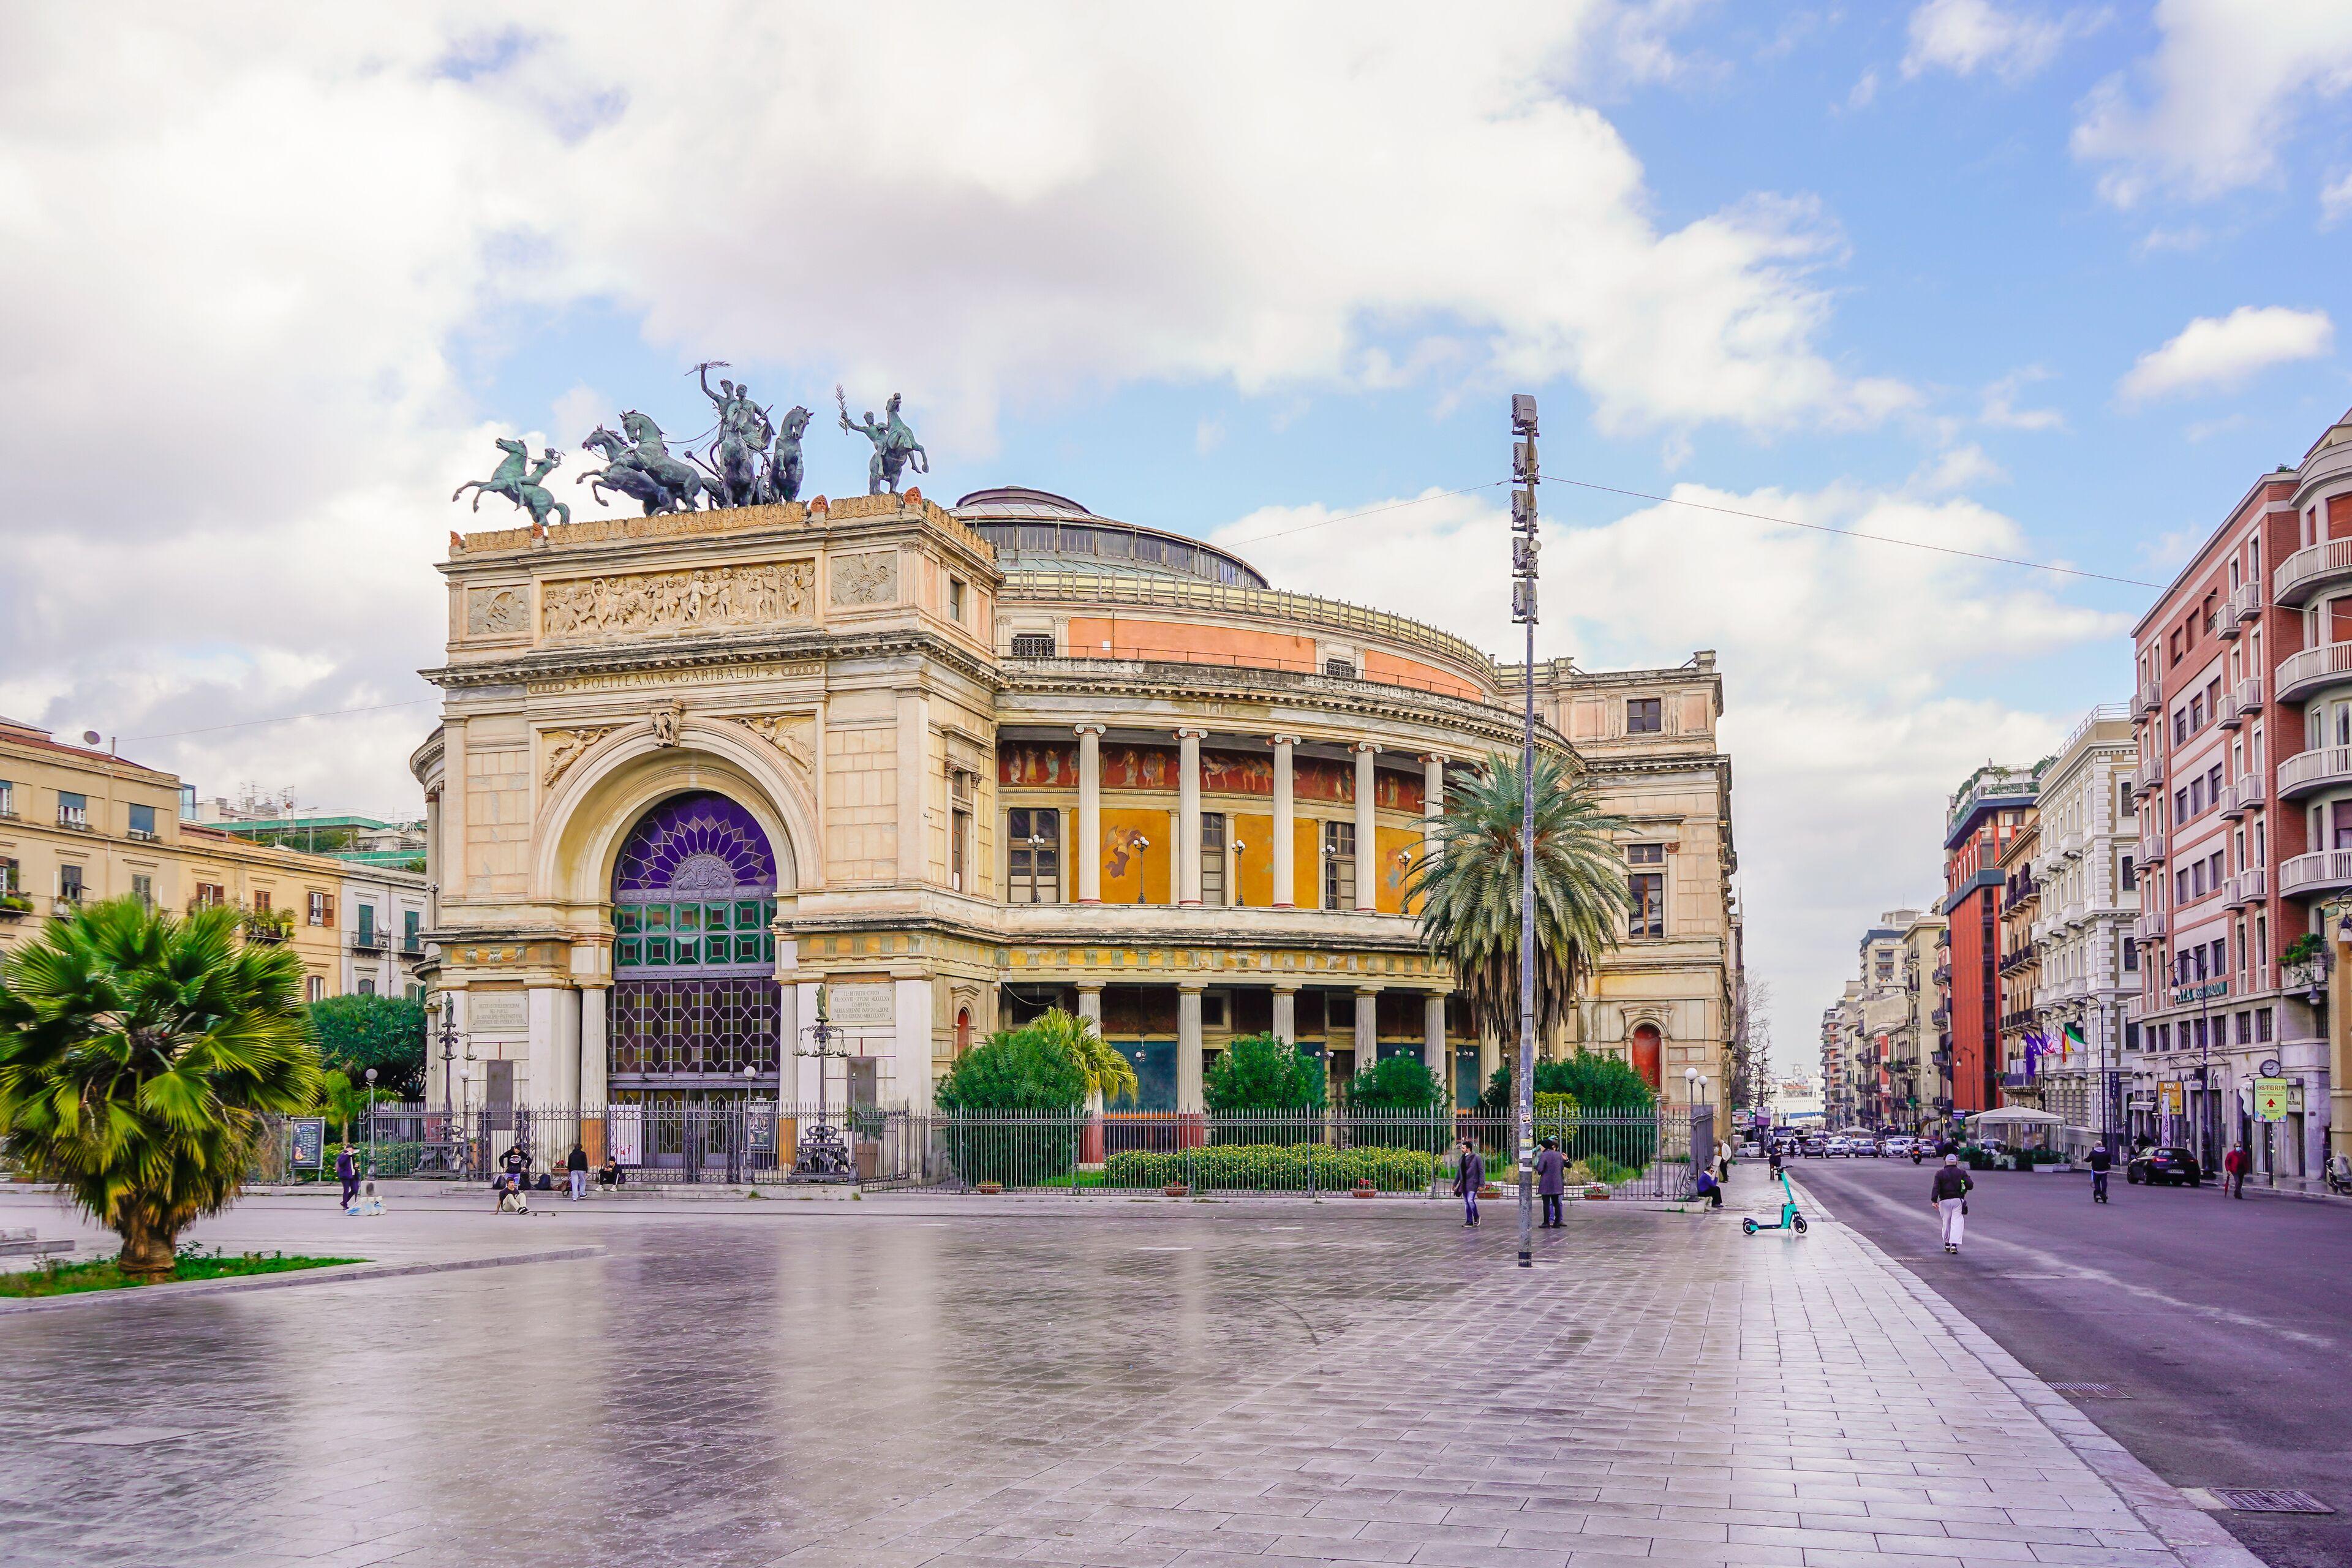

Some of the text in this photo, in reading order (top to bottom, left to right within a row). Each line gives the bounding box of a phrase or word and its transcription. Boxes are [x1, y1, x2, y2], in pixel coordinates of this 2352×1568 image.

[584, 666, 760, 690] POLITEAMA GARIBALDI
[2196, 981, 2225, 998] ASSURAZIONI
